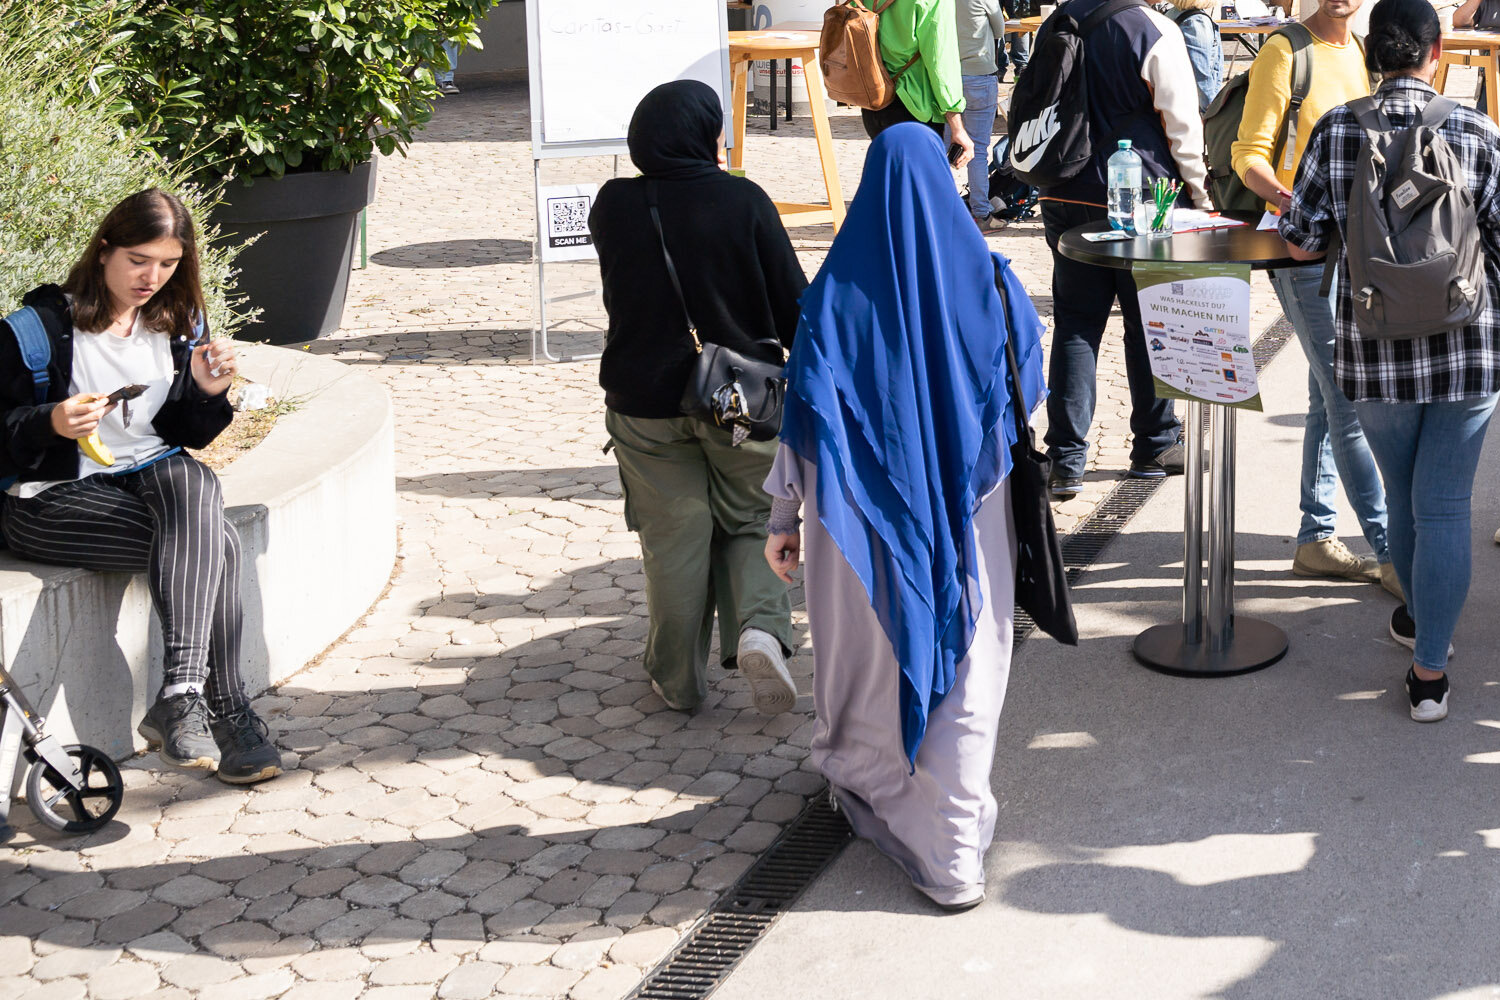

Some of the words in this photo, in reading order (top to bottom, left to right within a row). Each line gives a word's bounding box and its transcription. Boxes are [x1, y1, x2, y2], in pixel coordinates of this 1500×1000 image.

[554, 237, 576, 246] SCAN
[576, 236, 588, 245] ME
[1159, 295, 1174, 304] WAS
[1176, 298, 1210, 308] HACKELST
[1211, 302, 1226, 310] DU?
[1150, 303, 1169, 314] WIR
[1172, 307, 1213, 321] MACHEN
[1216, 314, 1239, 324] MIT!
